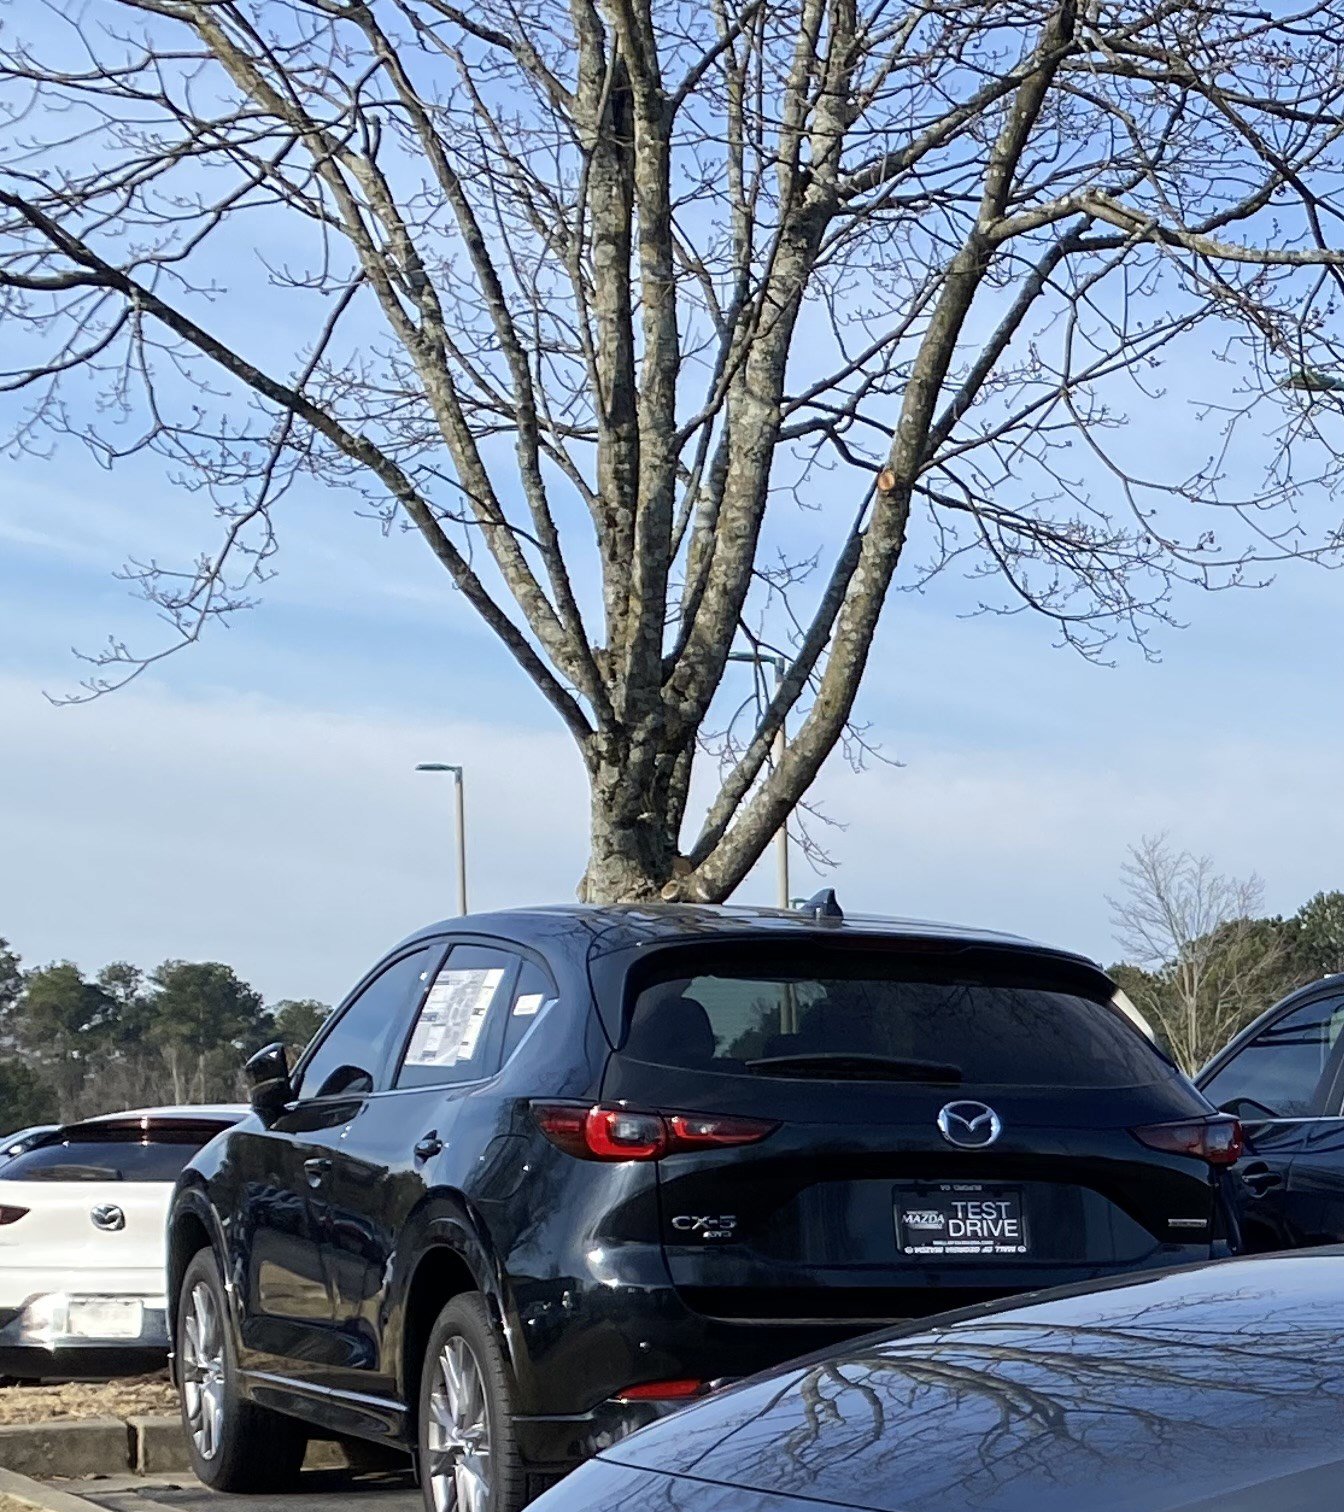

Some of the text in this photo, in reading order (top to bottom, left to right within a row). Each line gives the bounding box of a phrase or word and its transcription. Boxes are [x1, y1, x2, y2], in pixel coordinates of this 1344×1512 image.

[902, 1213, 945, 1224] MAZDA
[950, 1201, 1012, 1220] TEST
[671, 1215, 737, 1230] CX-5
[948, 1219, 1019, 1237] DRIVE
